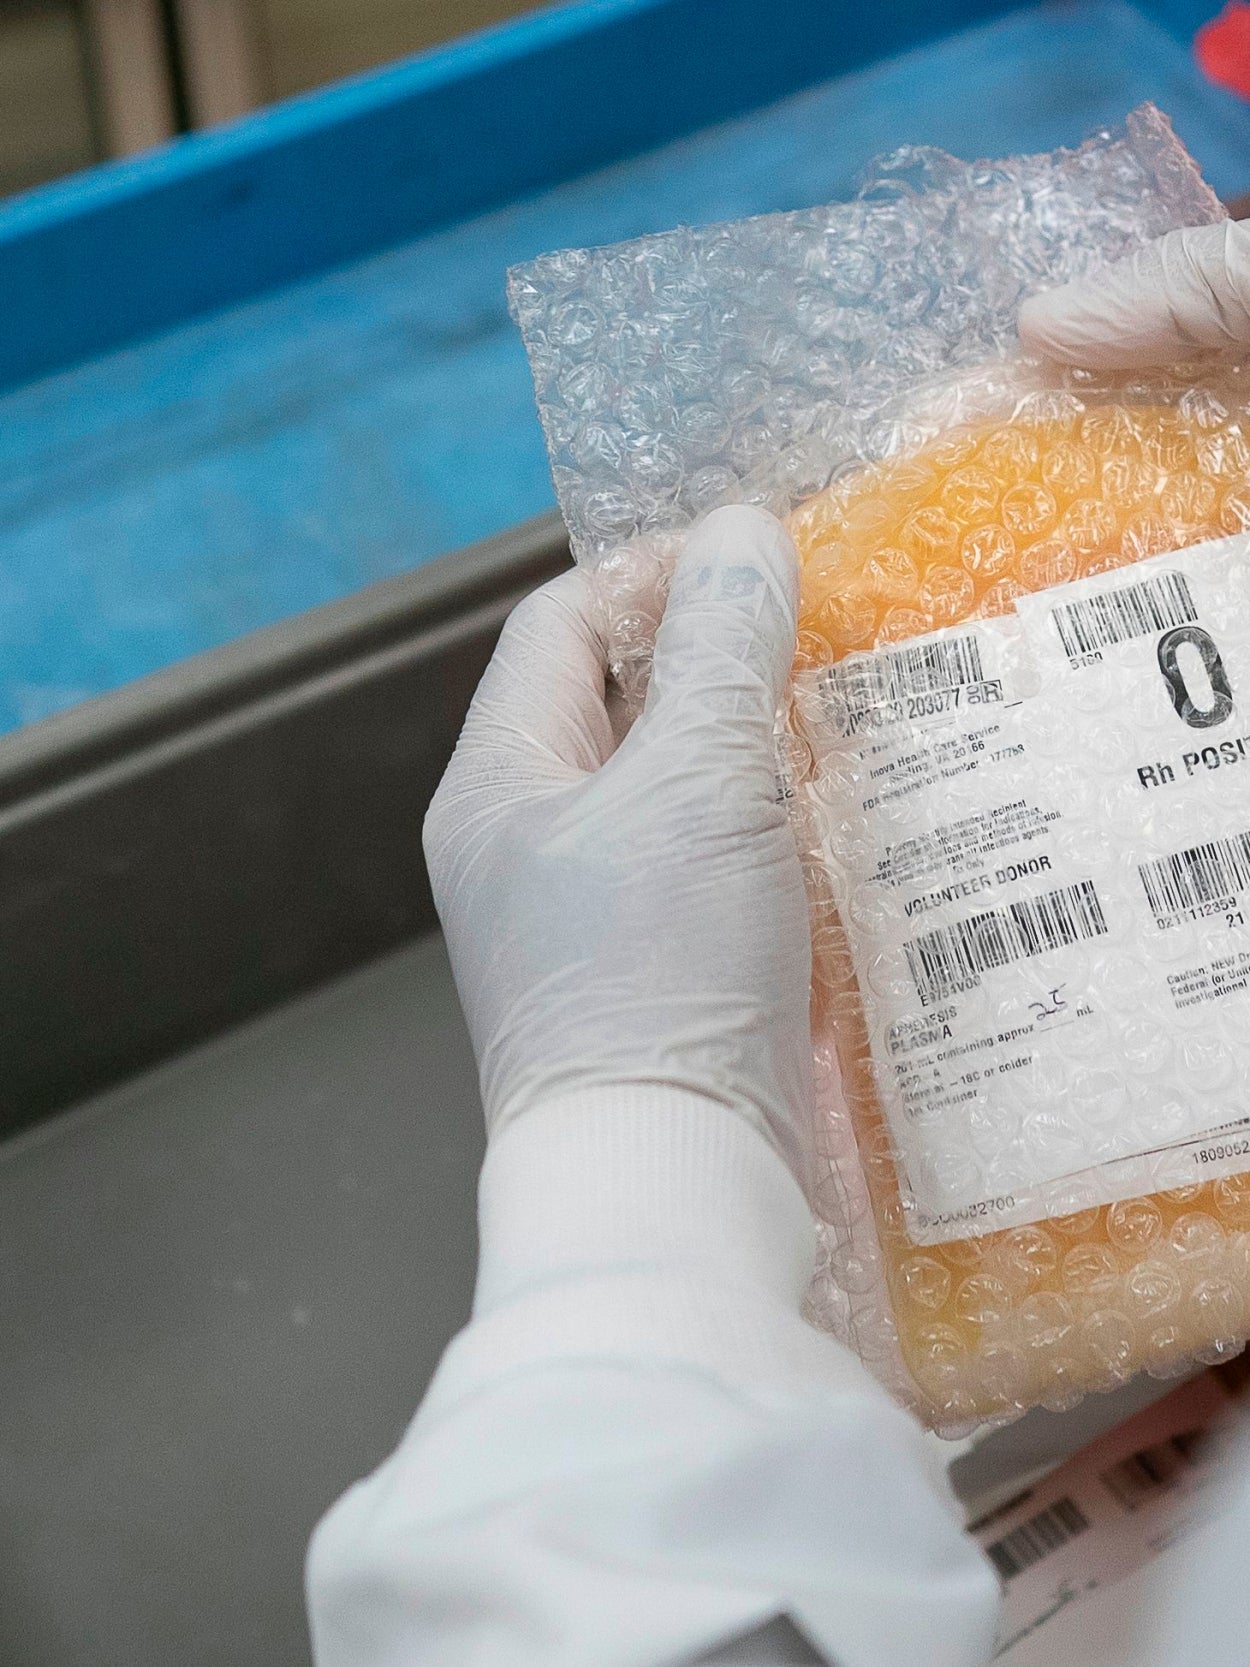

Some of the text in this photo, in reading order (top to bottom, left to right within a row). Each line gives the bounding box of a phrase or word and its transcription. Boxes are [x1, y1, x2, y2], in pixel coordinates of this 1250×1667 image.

[870, 762, 895, 779] Inova
[933, 738, 957, 753] Care
[962, 723, 1000, 743] Service
[862, 797, 880, 812] FDA
[941, 759, 980, 779] Number
[1137, 760, 1176, 791] Rh
[877, 859, 892, 871] See
[903, 874, 992, 918] VOLUNTEER
[995, 856, 1052, 885] DONOR
[1225, 911, 1245, 928] 21
[1211, 957, 1236, 971] NEW
[1170, 978, 1209, 997] Federal
[1211, 973, 1226, 986] (or
[1175, 979, 1248, 1010] investigational
[891, 1025, 952, 1055] PLASMA
[937, 1037, 994, 1062] containing
[997, 1024, 1036, 1044] approx
[1076, 1005, 1094, 1017] mL
[984, 1069, 996, 1078] or
[998, 1055, 1034, 1073] colder
